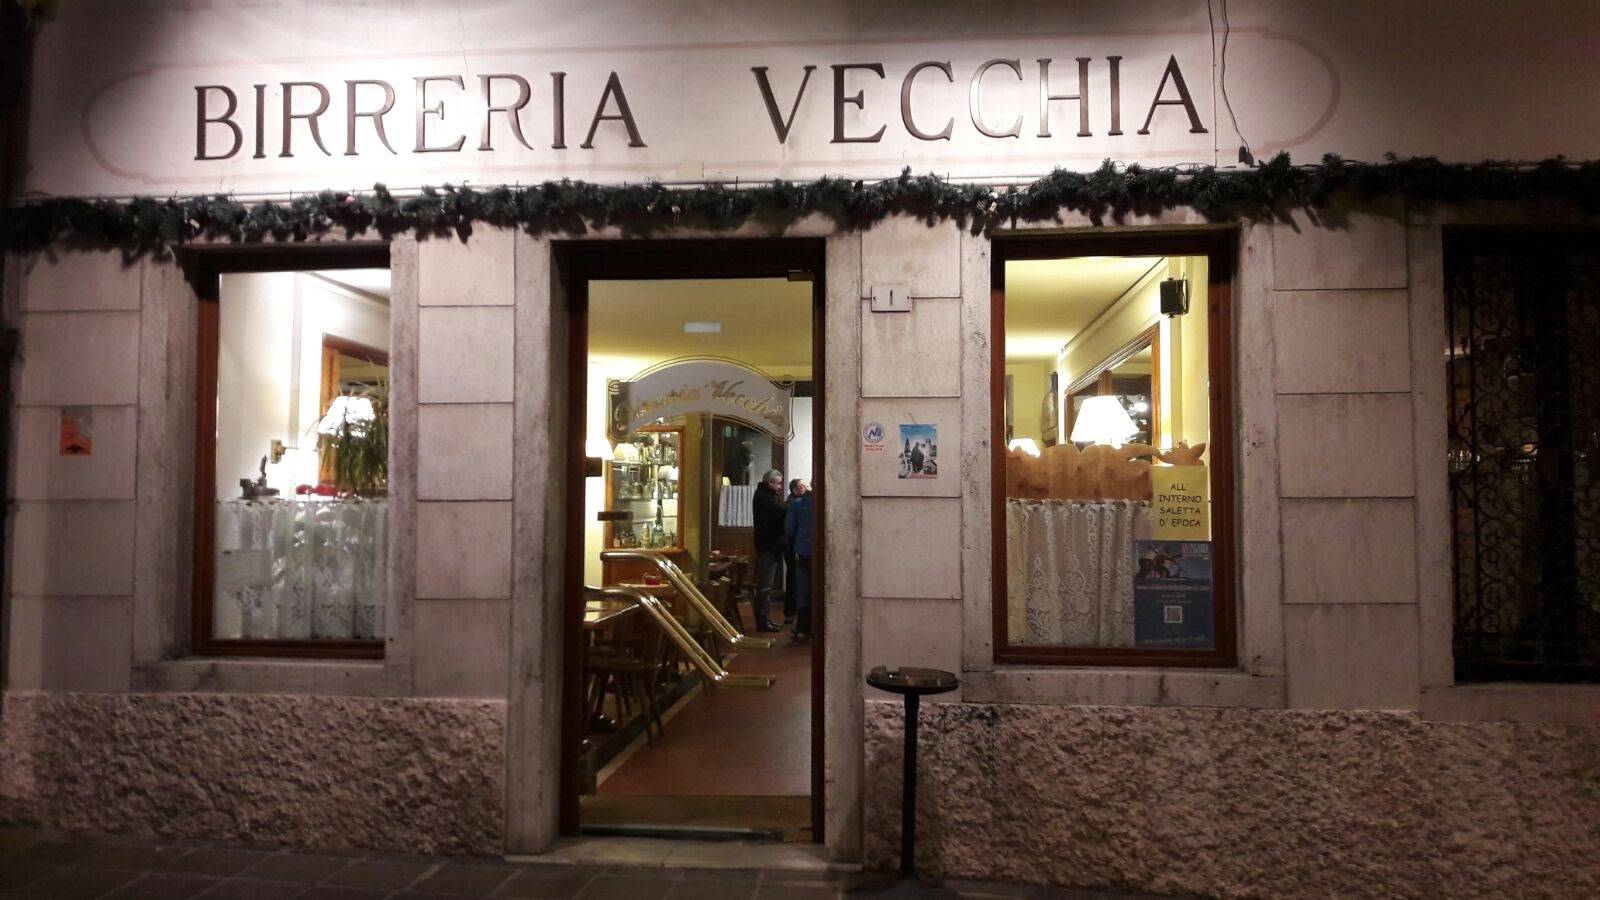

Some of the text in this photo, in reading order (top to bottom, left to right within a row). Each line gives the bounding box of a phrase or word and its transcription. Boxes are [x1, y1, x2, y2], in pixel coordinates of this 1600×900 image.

[194, 54, 1209, 161] BIRRERIA VECCHIA
[889, 289, 894, 306] 1
[1158, 494, 1202, 503] INTERNO
[1159, 506, 1201, 515] SALETTA
[1171, 518, 1201, 527] EPOCA
